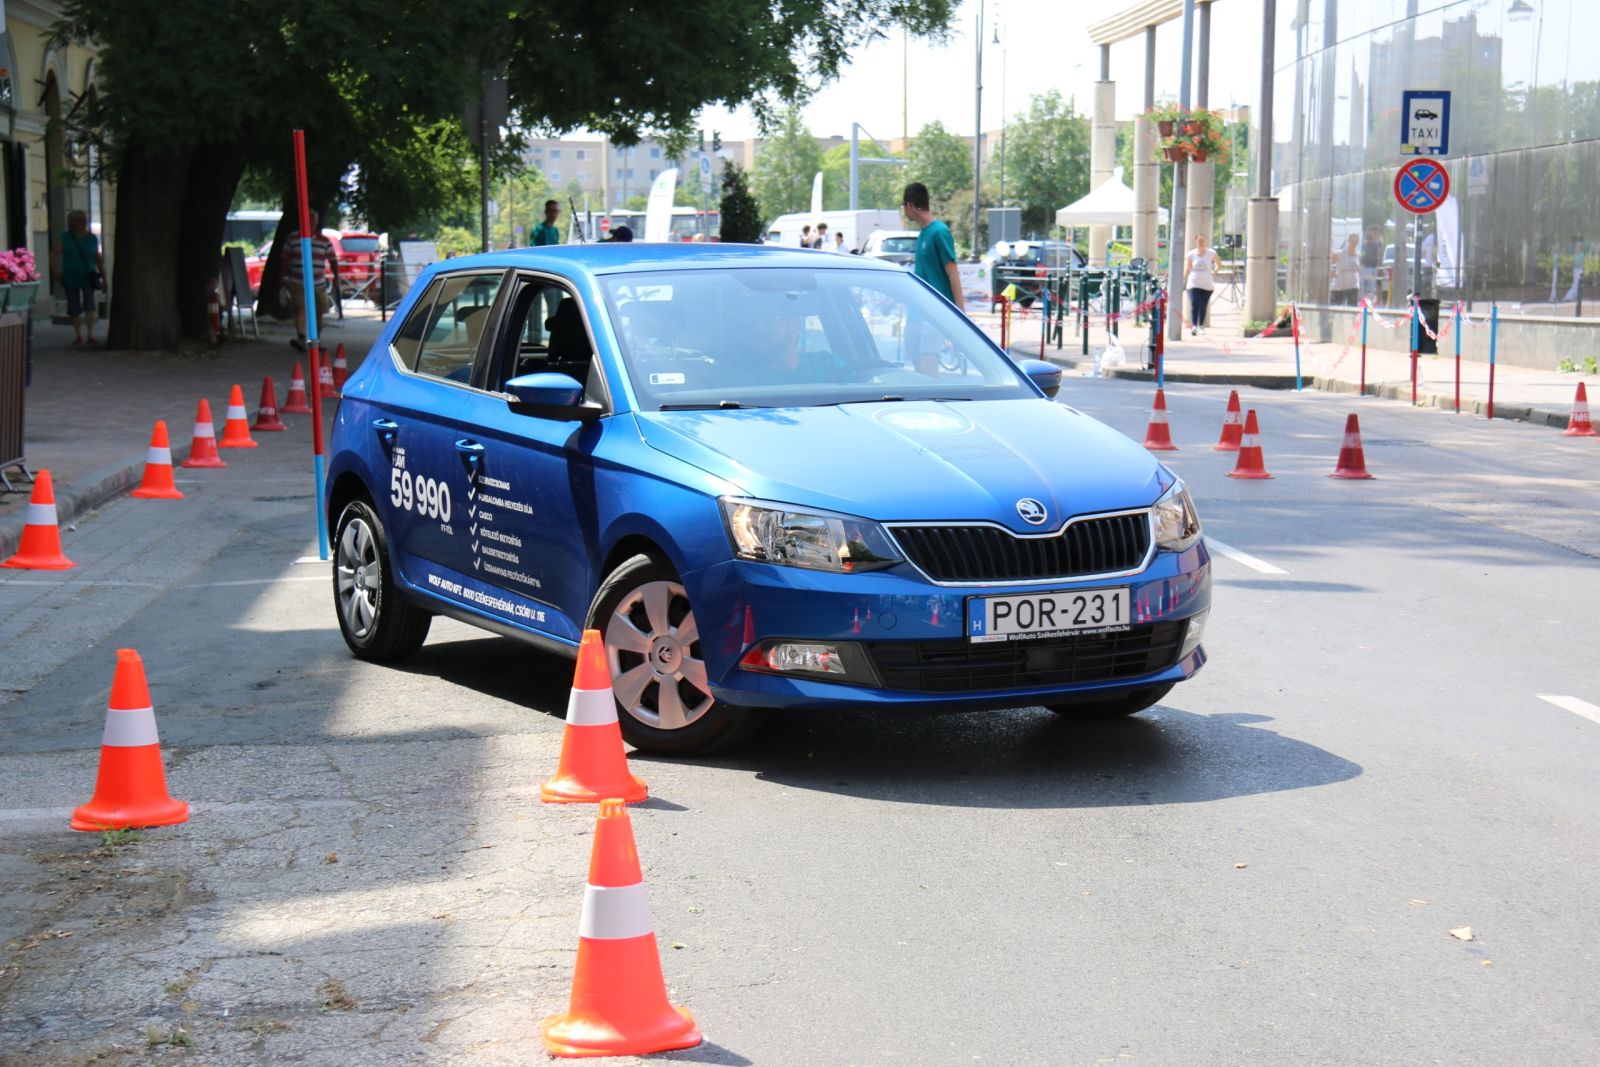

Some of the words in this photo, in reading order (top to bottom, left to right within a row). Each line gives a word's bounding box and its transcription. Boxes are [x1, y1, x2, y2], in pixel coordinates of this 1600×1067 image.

[1410, 128, 1438, 139] TAXI
[391, 468, 413, 511] 59
[416, 475, 451, 523] 990
[479, 510, 492, 521] CASCO
[429, 573, 441, 586] WOLF
[463, 587, 475, 600] 8000
[993, 593, 1120, 631] POR-231
[973, 620, 982, 631] H
[1009, 632, 1036, 641] WolfAuto
[1037, 629, 1080, 640] Székesfehérvár
[1082, 624, 1131, 635] www.wolfauto.hu
